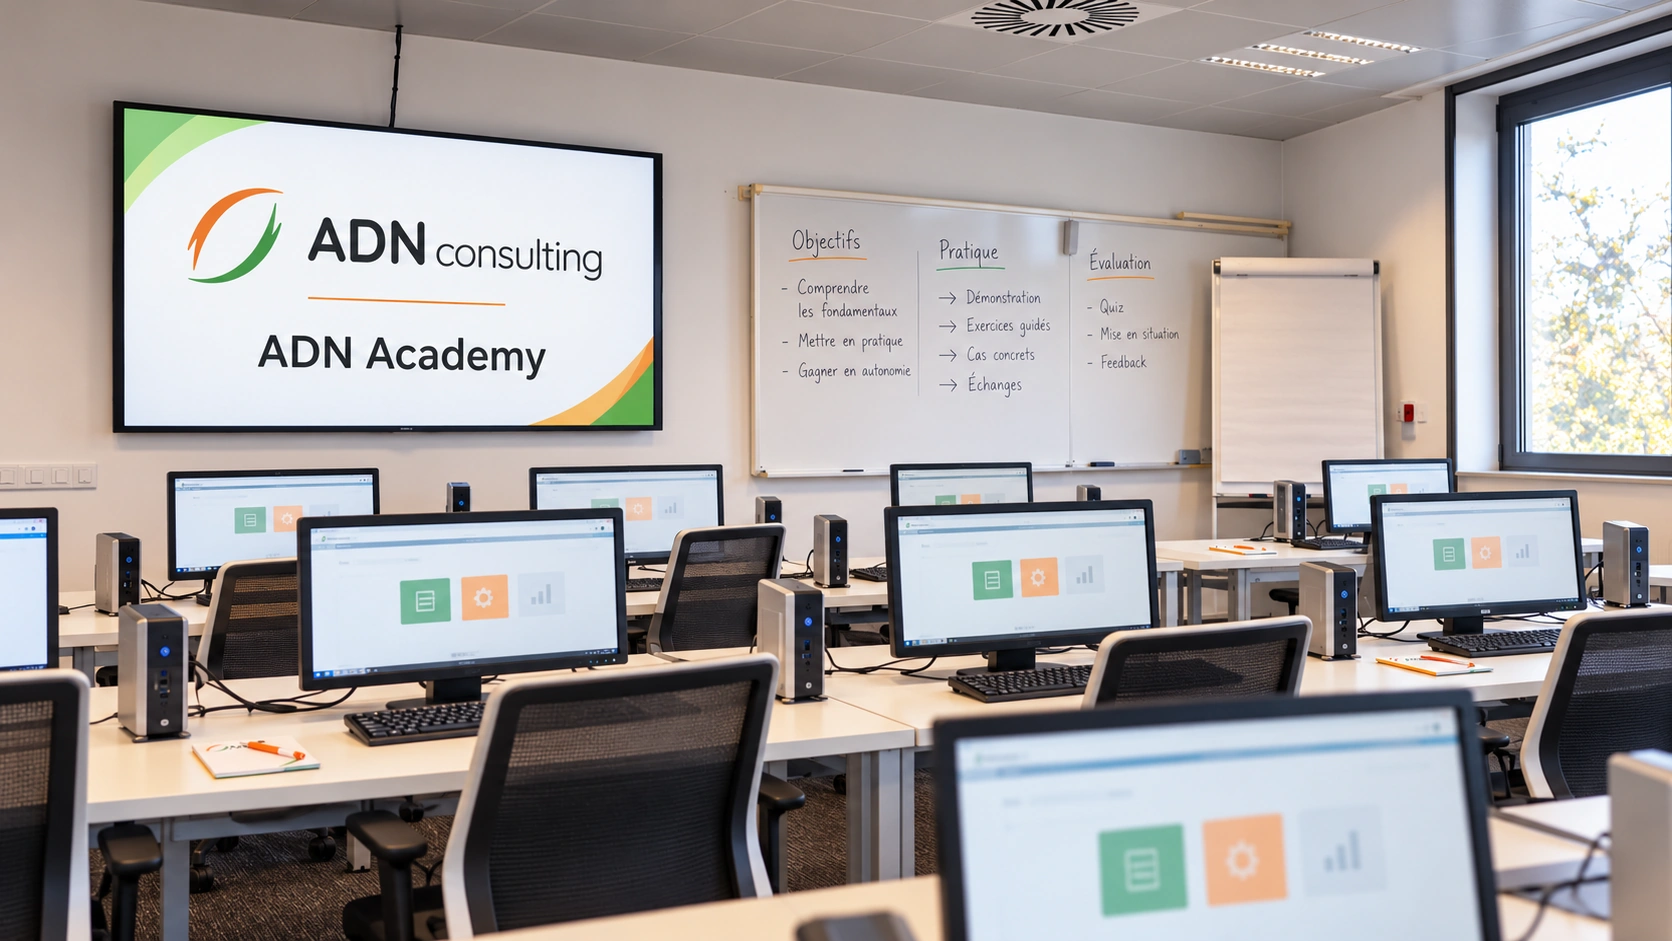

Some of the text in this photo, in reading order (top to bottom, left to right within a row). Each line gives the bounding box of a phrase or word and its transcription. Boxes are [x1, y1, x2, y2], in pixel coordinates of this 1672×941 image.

[307, 216, 603, 282] ADN consulting
[792, 228, 861, 259] Objectifs
[939, 238, 999, 267] Pratique
[1089, 247, 1152, 271] Évaluation
[797, 277, 870, 301] Comprendre
[966, 288, 1041, 305] Démonstration
[798, 301, 898, 319] les fondamentaux
[1099, 298, 1125, 316] Quiz
[966, 316, 1051, 338] Exercices guidés
[1100, 326, 1180, 341] Mise en situation
[798, 332, 904, 353] Mettre en pratique
[966, 345, 1035, 362] Cas concrets
[257, 334, 547, 381] ADN Academy
[1101, 353, 1148, 370] Feedback
[798, 361, 912, 385] Gagner en autonomie
[968, 371, 1023, 399] Échanges
